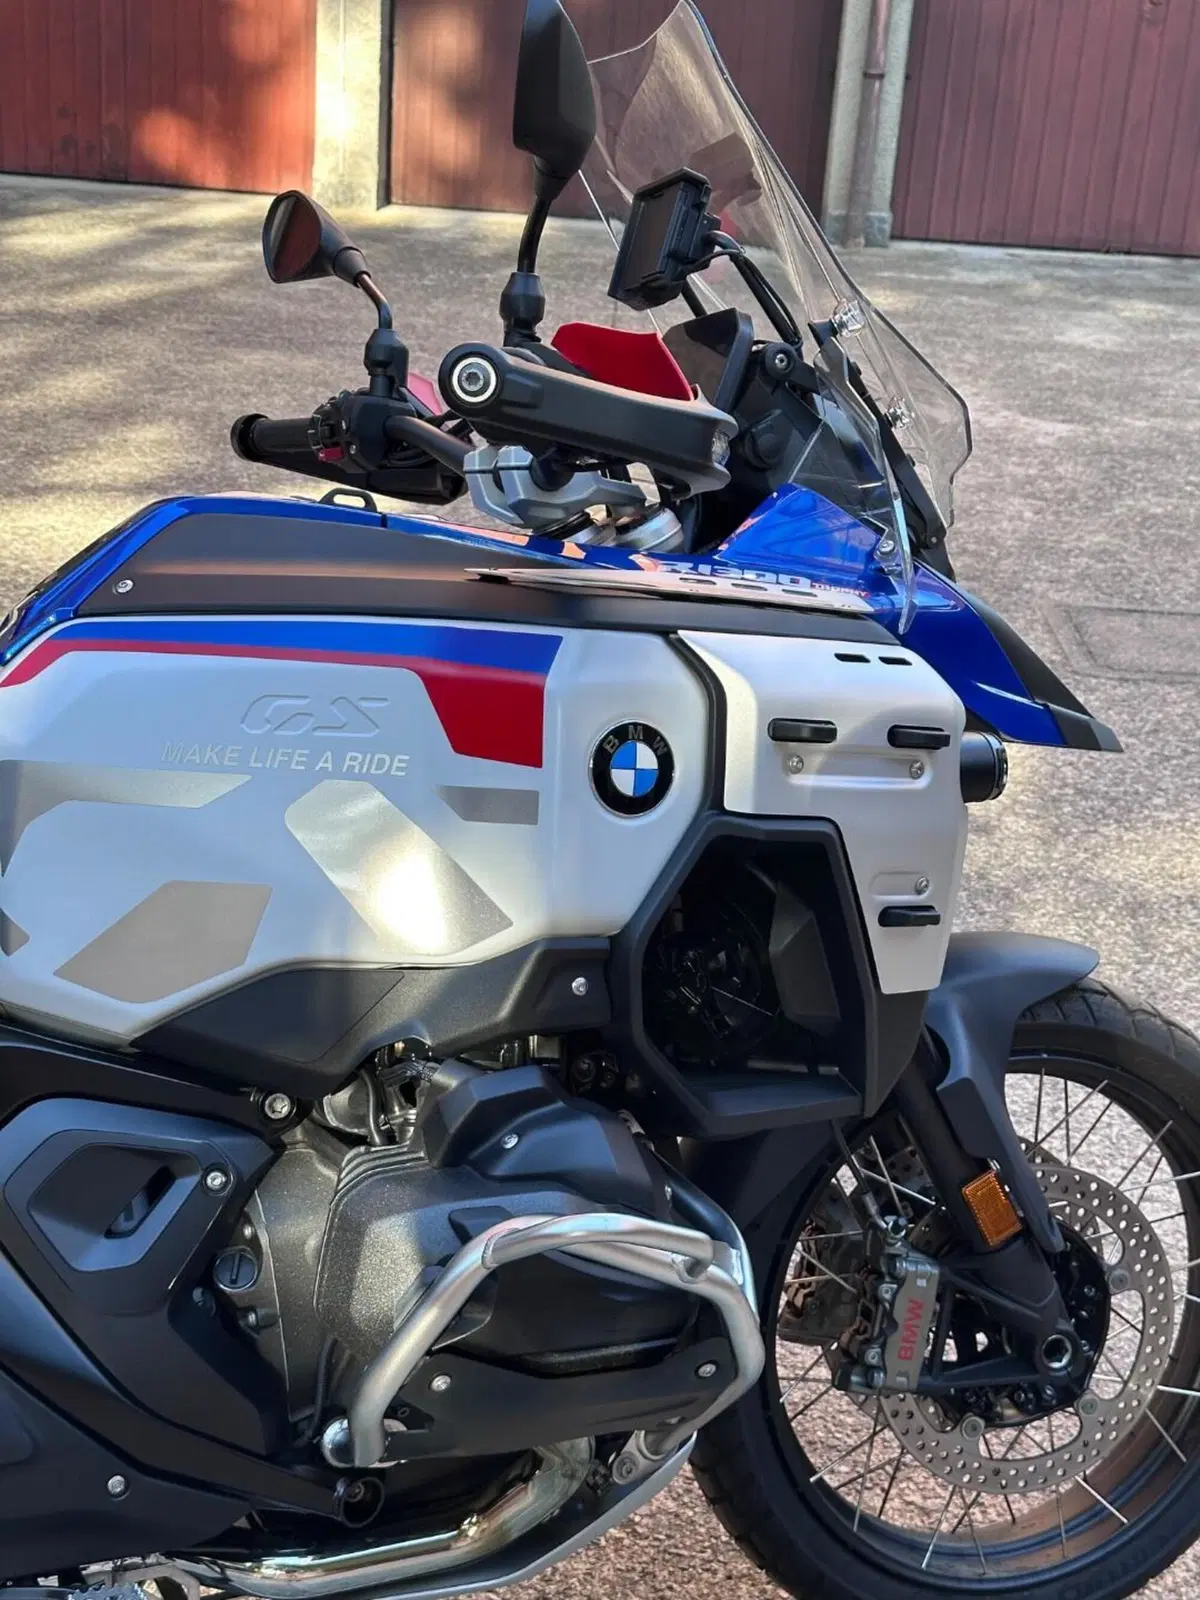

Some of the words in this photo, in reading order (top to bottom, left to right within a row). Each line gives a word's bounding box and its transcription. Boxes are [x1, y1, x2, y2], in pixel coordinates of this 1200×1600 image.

[240, 693, 391, 738] GS
[160, 741, 242, 766] MAKE
[248, 746, 310, 770] LIFE
[314, 751, 333, 772] A
[342, 751, 411, 777] RIDE
[602, 724, 669, 756] BMW
[897, 1297, 926, 1360] BMW
